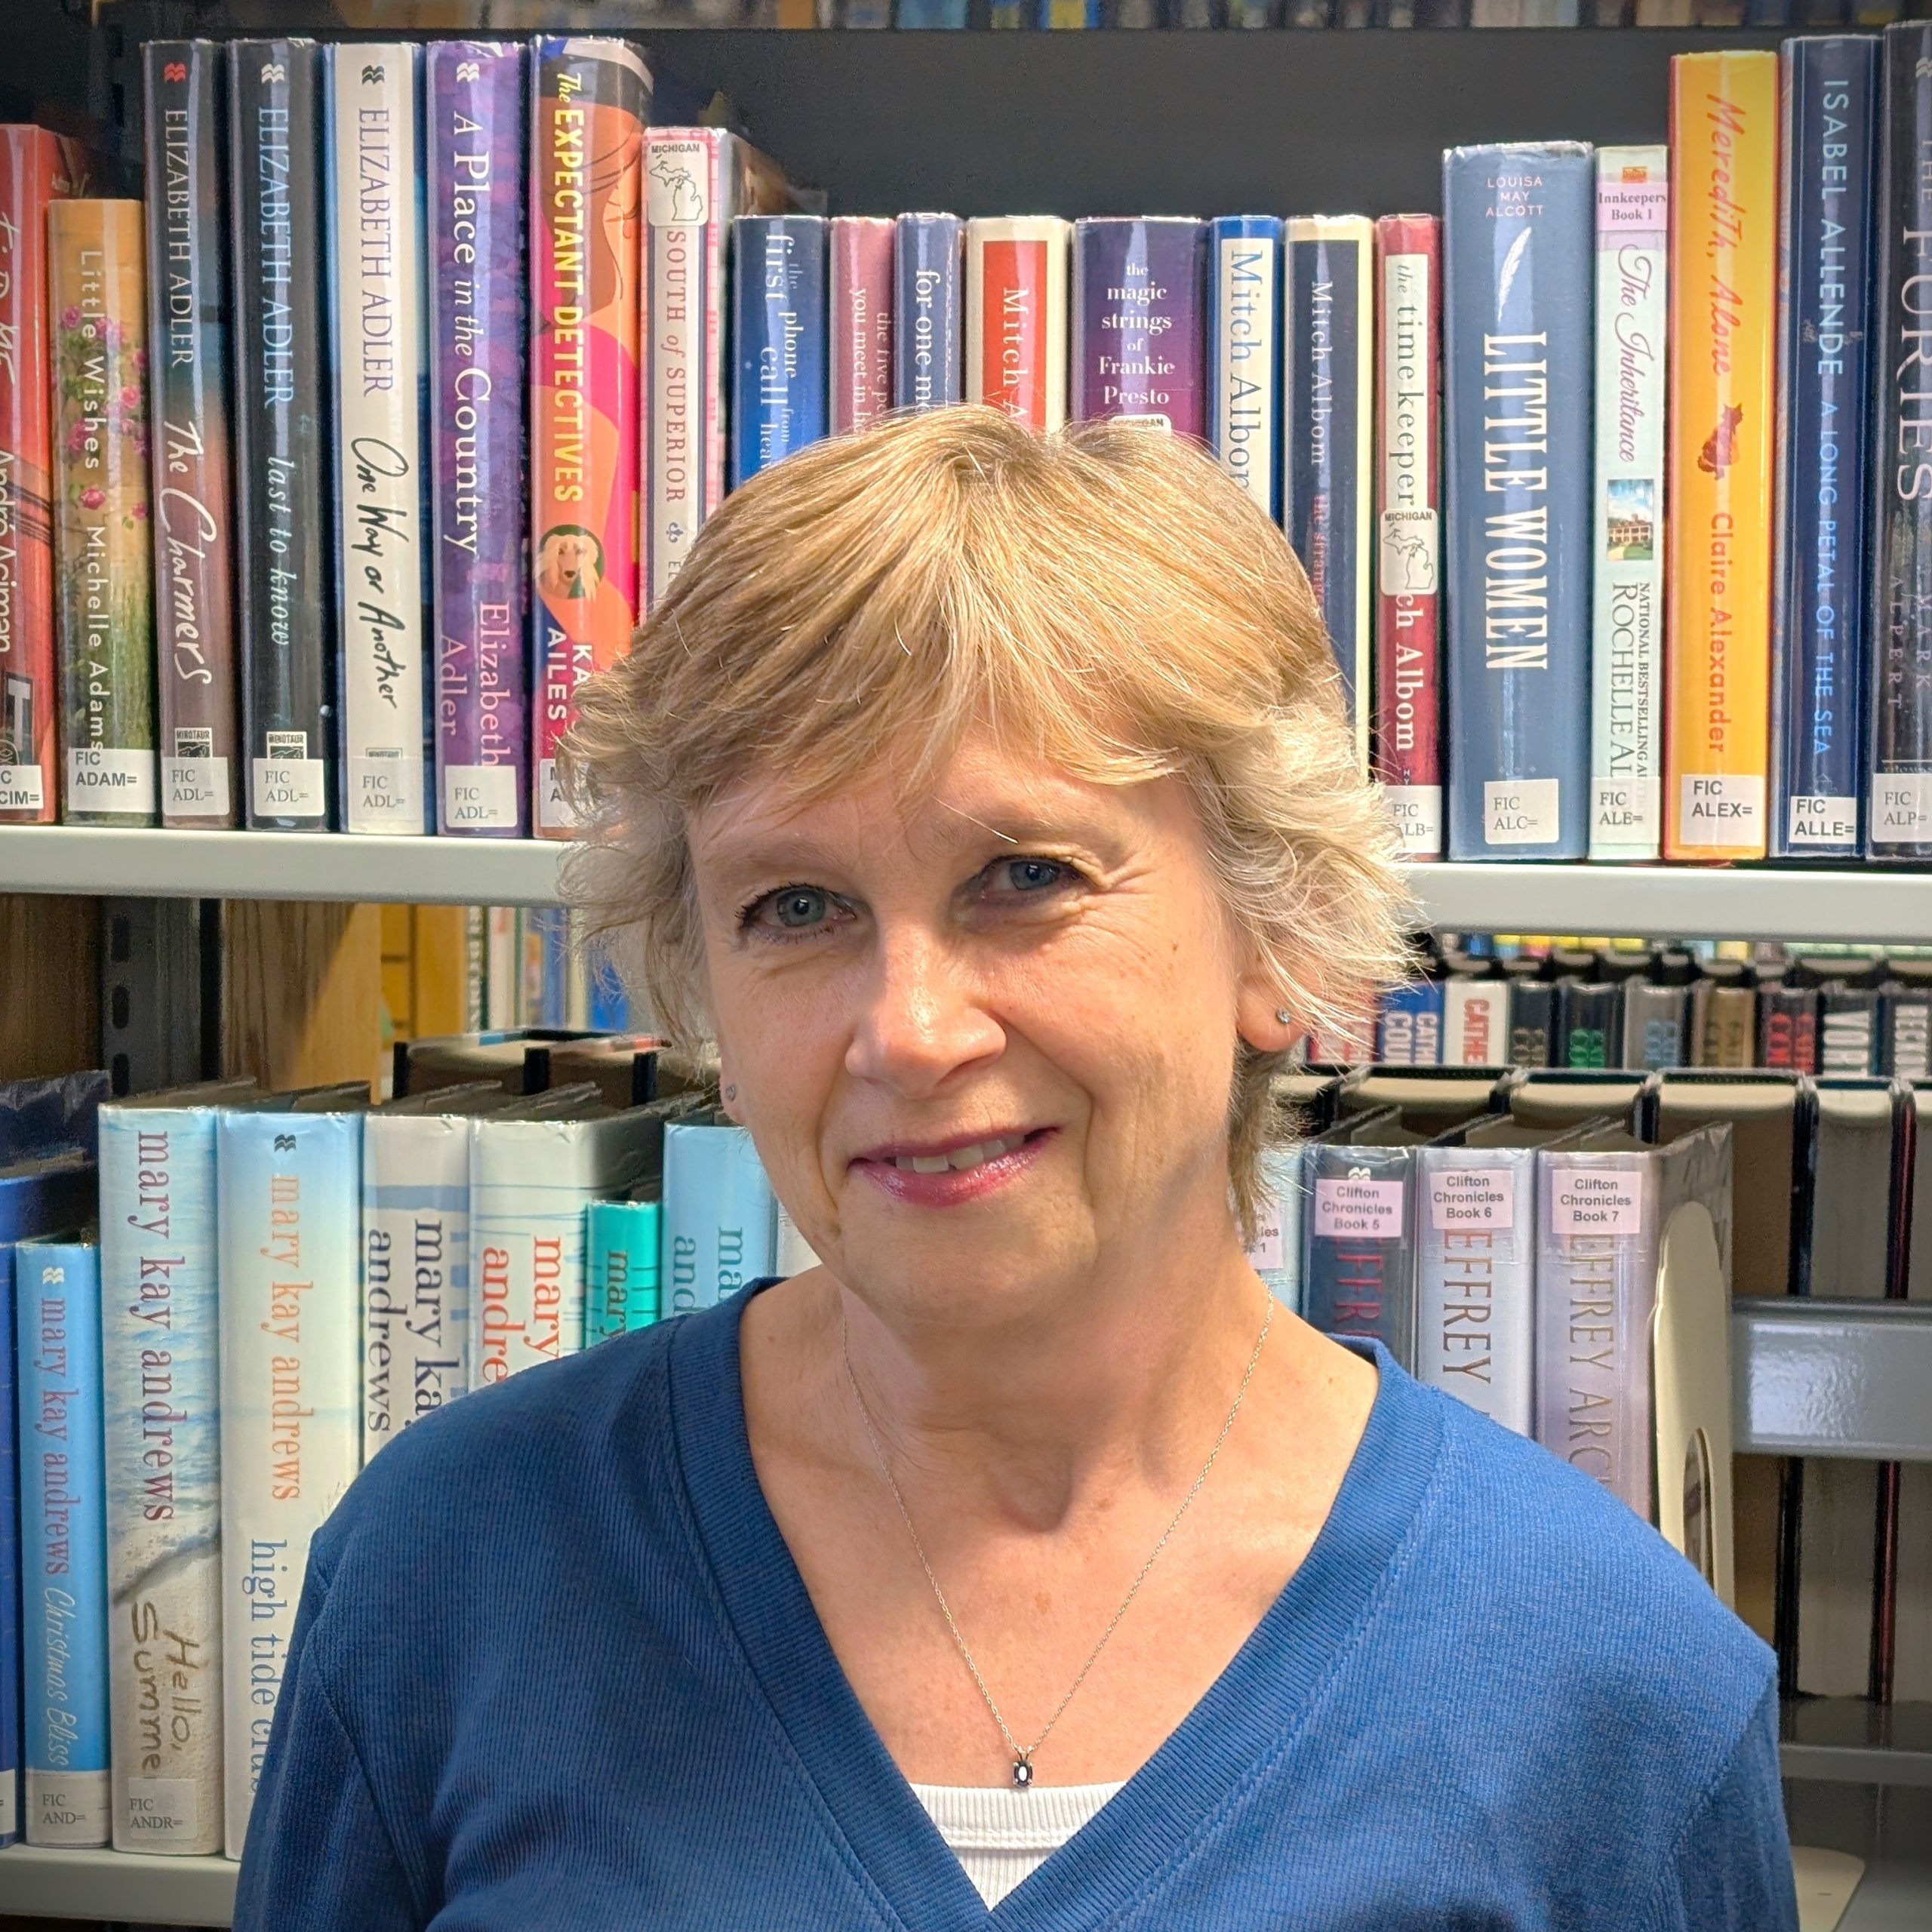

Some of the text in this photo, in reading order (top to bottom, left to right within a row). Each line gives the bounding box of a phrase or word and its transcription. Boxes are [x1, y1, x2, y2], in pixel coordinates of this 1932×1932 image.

[651, 143, 700, 153] MICHIGAN
[1487, 176, 1543, 188] LOUISA
[1500, 190, 1531, 202] MAY
[1485, 205, 1544, 217] ALCOTT
[1598, 192, 1666, 205] Innkeepers
[1611, 208, 1652, 220] Book 1
[1817, 80, 1850, 376] ISABEL ALLENDE
[165, 109, 194, 368] ELIZABETH ADLER
[1706, 94, 1747, 377] Meredith, Alone
[258, 108, 295, 409] ELIZABETH ADLER
[358, 108, 394, 397] ELIZABETH ADLER
[764, 235, 795, 300] first
[789, 263, 808, 290] the
[1126, 263, 1149, 276] the
[1397, 264, 1411, 293] the
[553, 72, 586, 502] The EXPECTANT DETECTIVES
[915, 269, 941, 308] for
[1106, 281, 1168, 306] magic
[849, 289, 867, 323] you
[1229, 250, 1263, 363] Mitch
[444, 115, 492, 554] A Place in the Country
[876, 312, 891, 342] the
[1002, 288, 1029, 387] Mitch
[1101, 310, 1172, 336] strings
[779, 311, 804, 378] phone
[854, 332, 869, 379] meet
[915, 316, 933, 365] one
[1126, 338, 1143, 352] of
[1614, 244, 1654, 463] The Inheritance
[81, 250, 107, 469] Little Wishes
[660, 229, 687, 503] SOUTH of SUPERIOR
[876, 349, 892, 385] five
[1099, 355, 1175, 375] Frankie
[1310, 281, 1334, 466] Mitch Albom
[760, 347, 789, 405] call
[854, 385, 872, 404] in
[1104, 386, 1170, 405] Presto
[775, 408, 790, 443] from
[350, 437, 409, 493] One
[1484, 332, 1549, 669] LITTLE WOMEN
[351, 504, 409, 558] Way
[1384, 512, 1432, 521] MICHIGAN
[159, 420, 217, 684] The Charmers
[267, 457, 297, 645] last to know
[364, 565, 384, 595] or
[1813, 401, 1839, 756] A LONG PETAL OF THE SEA
[0, 548, 17, 652] Aciman
[1639, 582, 1651, 657] NATIONAL
[1708, 513, 1734, 753] Claire Alexander
[87, 526, 109, 752] Michelle Adams
[1887, 576, 1904, 709] ALPERT
[358, 601, 408, 709] Another
[1610, 582, 1639, 734] ROCHELLE
[441, 635, 467, 737] Adler
[478, 601, 511, 766] Elizabeth
[548, 627, 567, 721] AILES
[1395, 643, 1424, 752] Albom
[1636, 660, 1650, 761] BESTSELLING
[75, 752, 101, 765] FIC
[75, 772, 137, 786] ADAM=
[171, 770, 195, 783] FIC
[265, 771, 291, 783] FIC
[362, 776, 388, 789] FIC
[1693, 780, 1722, 795] FIC
[172, 789, 214, 801] ADL=
[266, 789, 309, 802] ADL=
[363, 795, 405, 808] ADL=
[454, 787, 479, 801] FIC
[1494, 797, 1520, 810] FIC
[1599, 792, 1626, 806] FIC
[1795, 799, 1826, 814] FIC
[1884, 791, 1912, 805] FIC
[454, 807, 498, 820] ADL=
[1392, 804, 1419, 817] FIC
[1494, 817, 1538, 830] ALC=
[1598, 811, 1643, 826] ALE=
[1691, 802, 1752, 818] ALEX=
[1883, 811, 1927, 826] ALP=
[1794, 821, 1855, 836] ALLE=
[1336, 1186, 1380, 1198] Clifton
[1446, 1175, 1490, 1187] Clifton
[1574, 1178, 1618, 1191] Clifton
[1321, 1201, 1392, 1215] Chronicles
[1433, 1190, 1504, 1204] Chronicles
[1560, 1193, 1632, 1207] Chronicles
[1334, 1217, 1380, 1230] Book 5
[1446, 1206, 1492, 1219] Book 6
[1573, 1209, 1619, 1222] Book 7
[405, 1218, 443, 1349] mary
[523, 1236, 561, 1360] mary
[127, 1131, 188, 1522] mary kay andrews
[260, 1174, 315, 1500] mary kay andrews
[367, 1229, 408, 1432] andrews
[33, 1297, 81, 1575] mary kay andrews
[242, 1539, 288, 1622] high
[44, 1587, 77, 1767] Christmas Bliss
[250, 1633, 285, 1706] tide
[131, 1601, 162, 1779] Summe
[163, 1629, 202, 1752] Hello,
[42, 1792, 66, 1807] FIC
[129, 1798, 154, 1811] FIC
[42, 1811, 87, 1825] AND=
[130, 1815, 183, 1829] ANDR=
